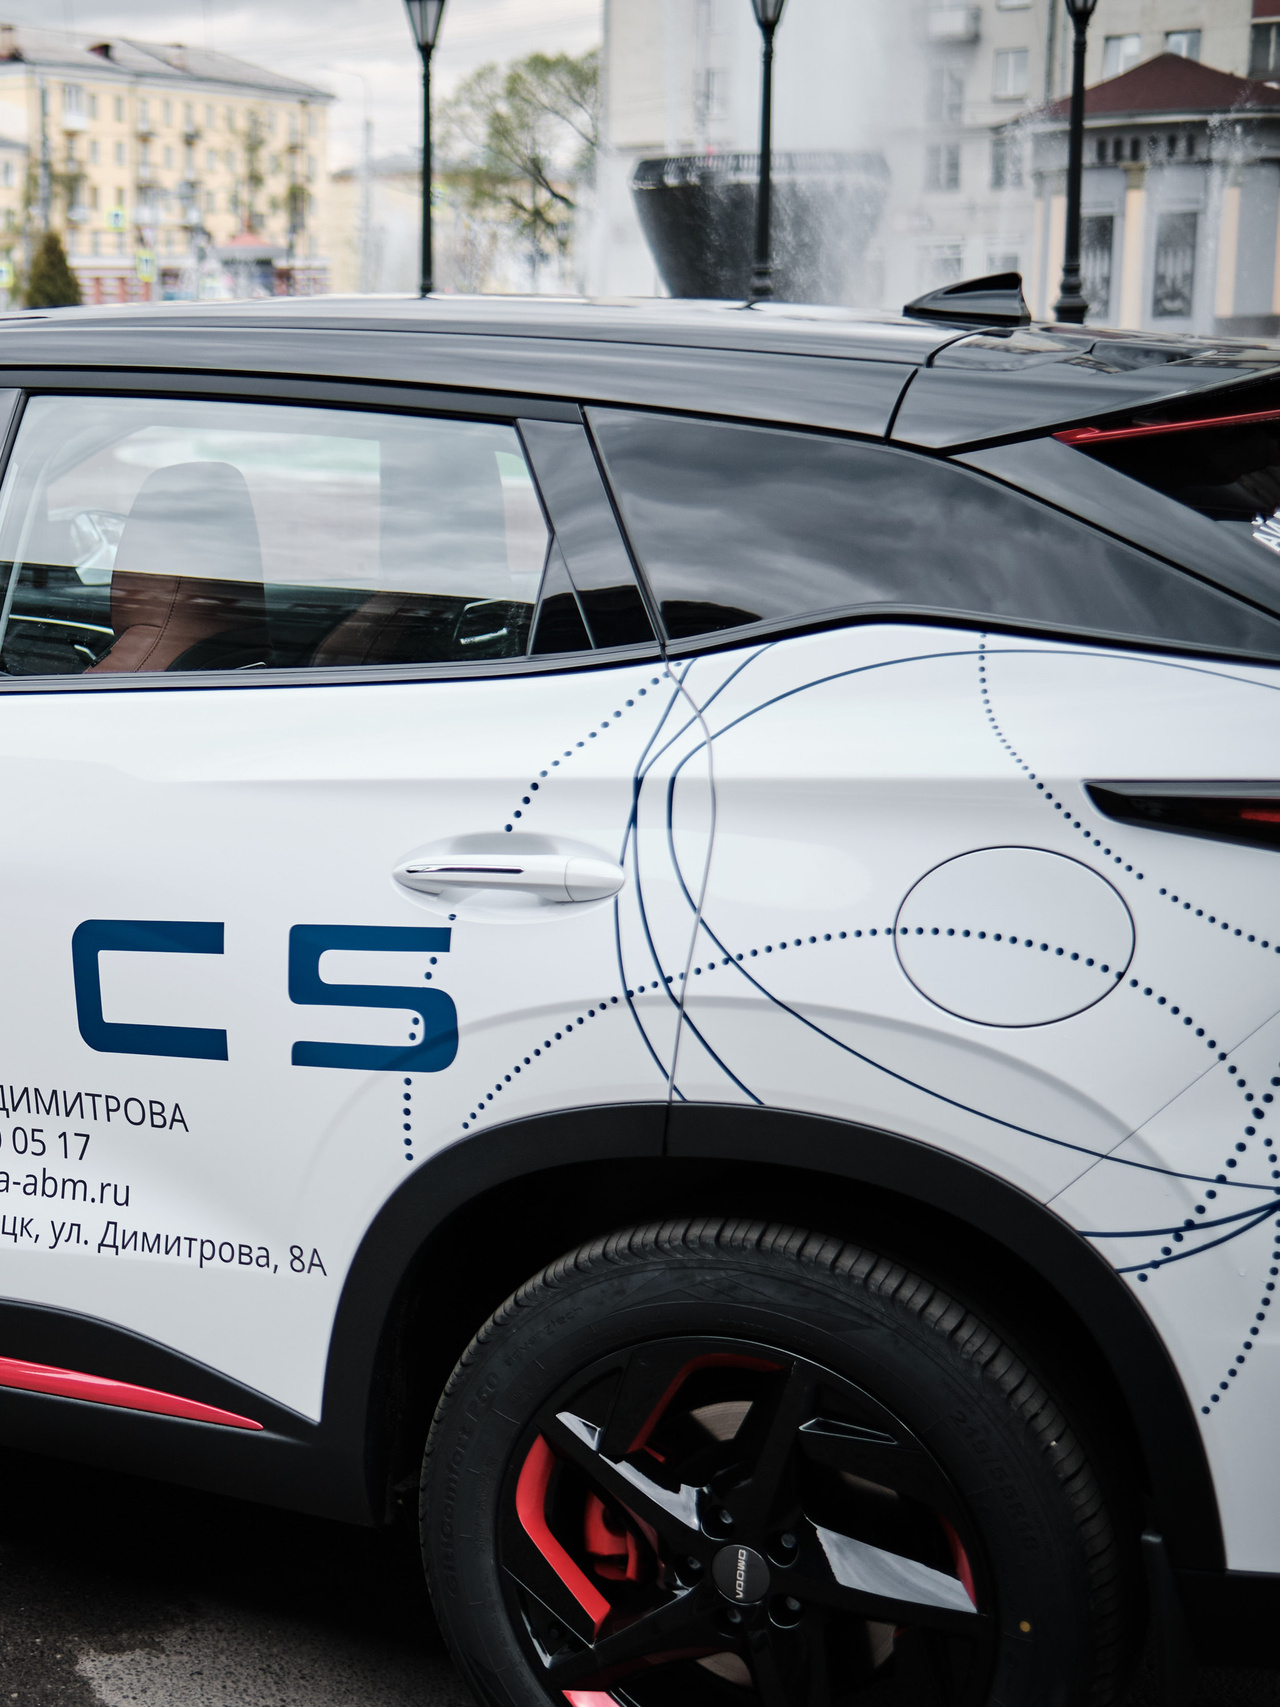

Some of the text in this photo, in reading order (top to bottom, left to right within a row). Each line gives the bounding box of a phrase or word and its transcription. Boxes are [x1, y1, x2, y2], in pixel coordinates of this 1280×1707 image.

[12, 1126, 47, 1157] 05
[57, 1131, 91, 1161] 17
[48, 1220, 89, 1250] ул.
[97, 1220, 279, 1274] Димитрова,
[289, 1244, 328, 1277] 8А
[734, 1548, 748, 1599] OMODA
